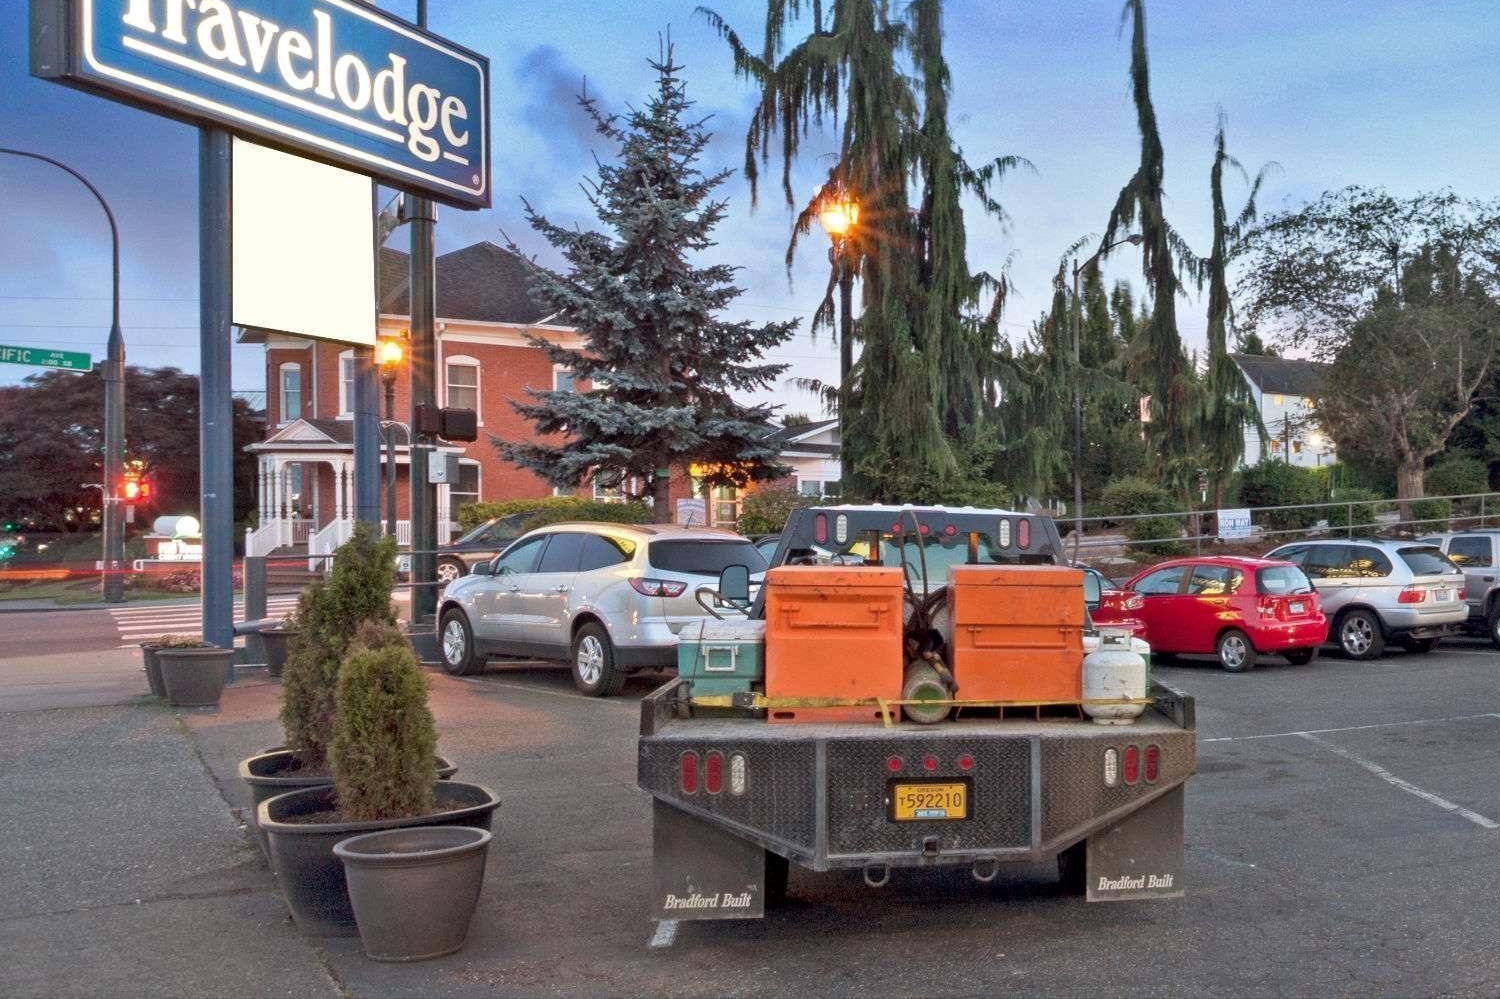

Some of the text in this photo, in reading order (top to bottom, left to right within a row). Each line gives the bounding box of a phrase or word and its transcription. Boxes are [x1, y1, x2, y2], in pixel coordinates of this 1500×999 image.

[0, 347, 32, 363] IFIC
[898, 792, 962, 809] T592210
[1097, 873, 1175, 891] Bradford Built
[663, 892, 752, 909] Bradford Built
